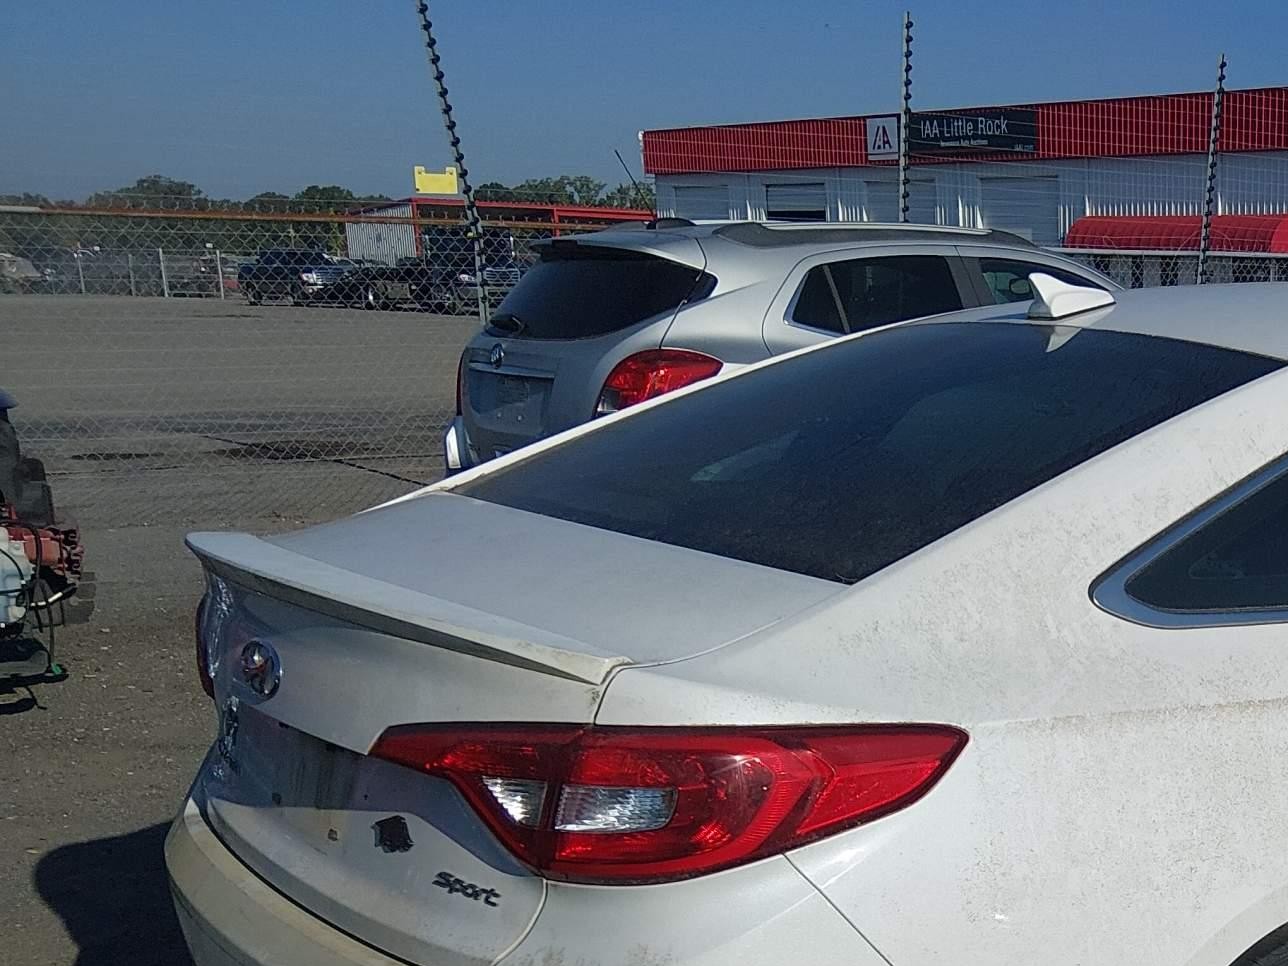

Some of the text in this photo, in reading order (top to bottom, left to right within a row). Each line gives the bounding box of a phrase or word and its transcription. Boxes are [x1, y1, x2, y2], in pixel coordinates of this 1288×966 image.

[921, 115, 1008, 138] IAA Little Rock
